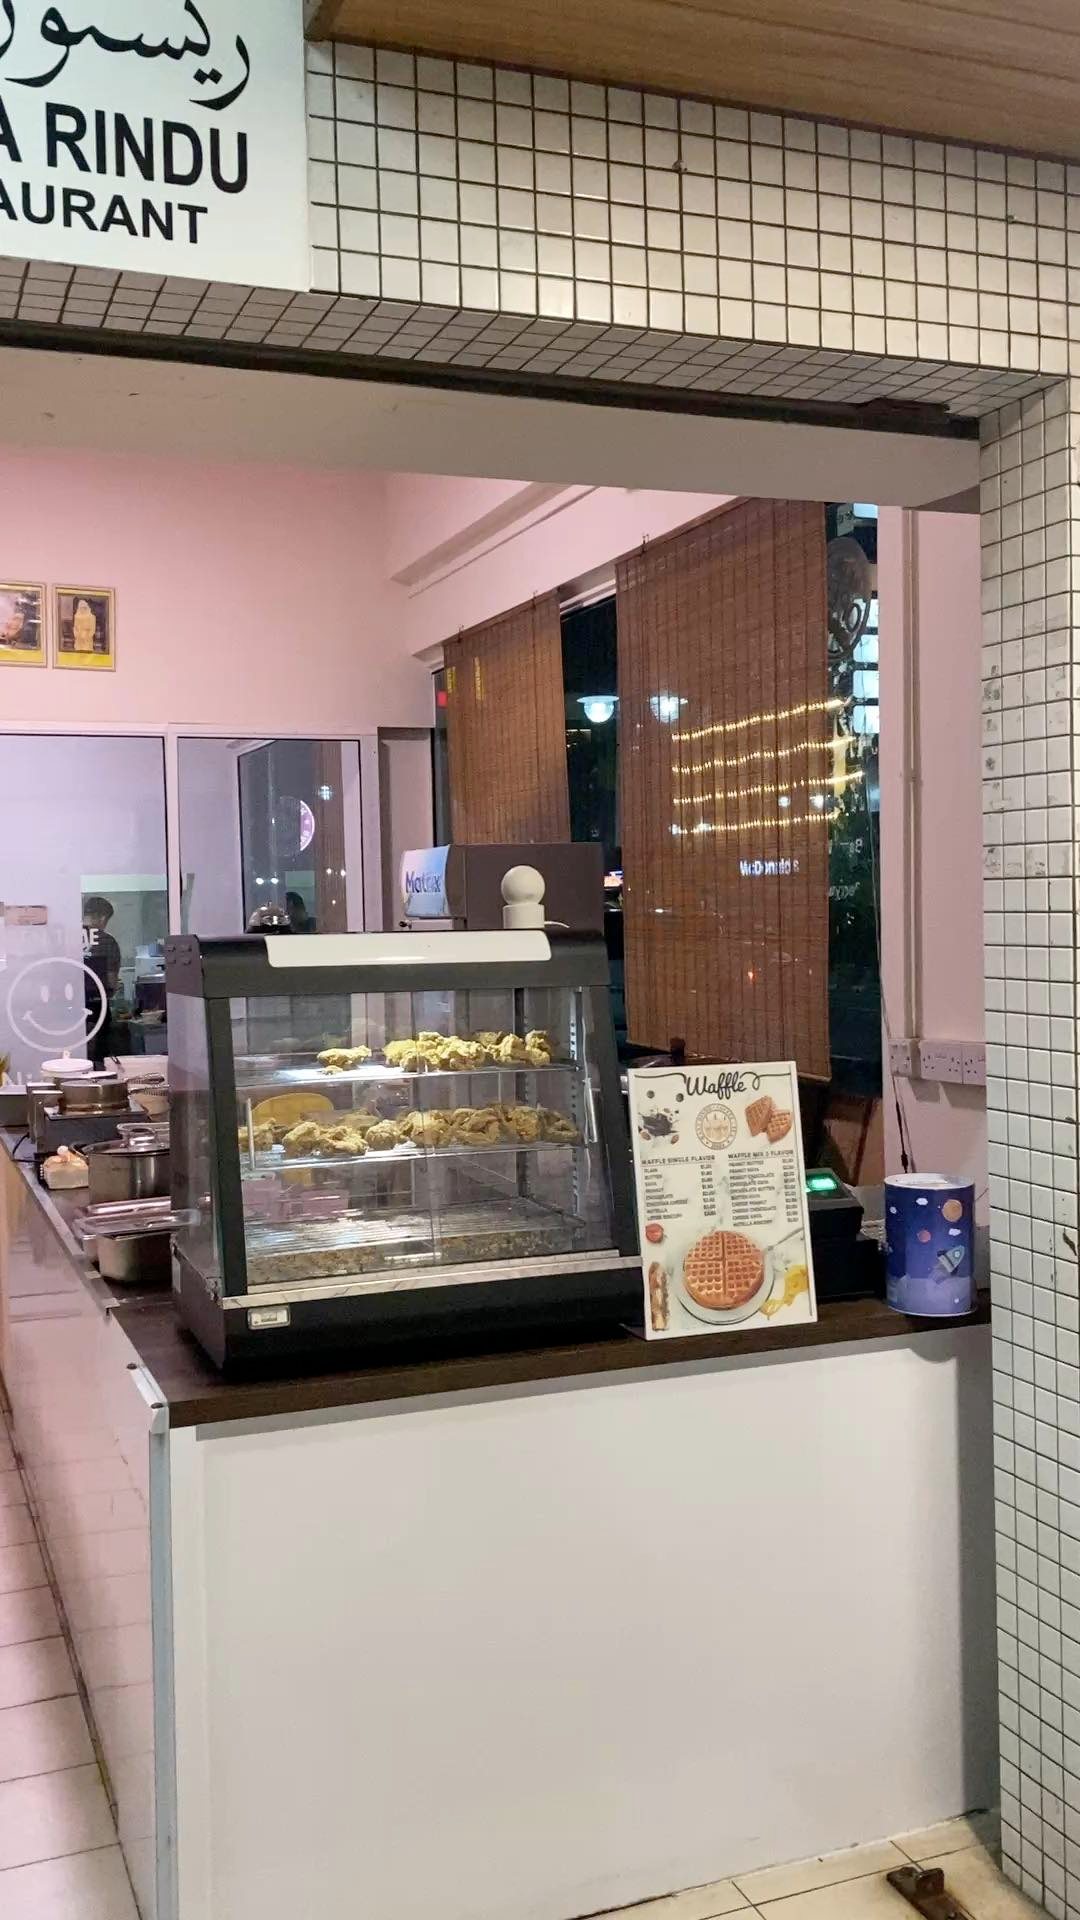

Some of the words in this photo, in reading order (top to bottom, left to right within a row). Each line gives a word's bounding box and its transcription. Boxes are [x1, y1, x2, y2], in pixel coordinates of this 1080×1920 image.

[46, 102, 247, 194] RINDU
[739, 858, 800, 876] McDonalds
[686, 1071, 747, 1100] Waffle
